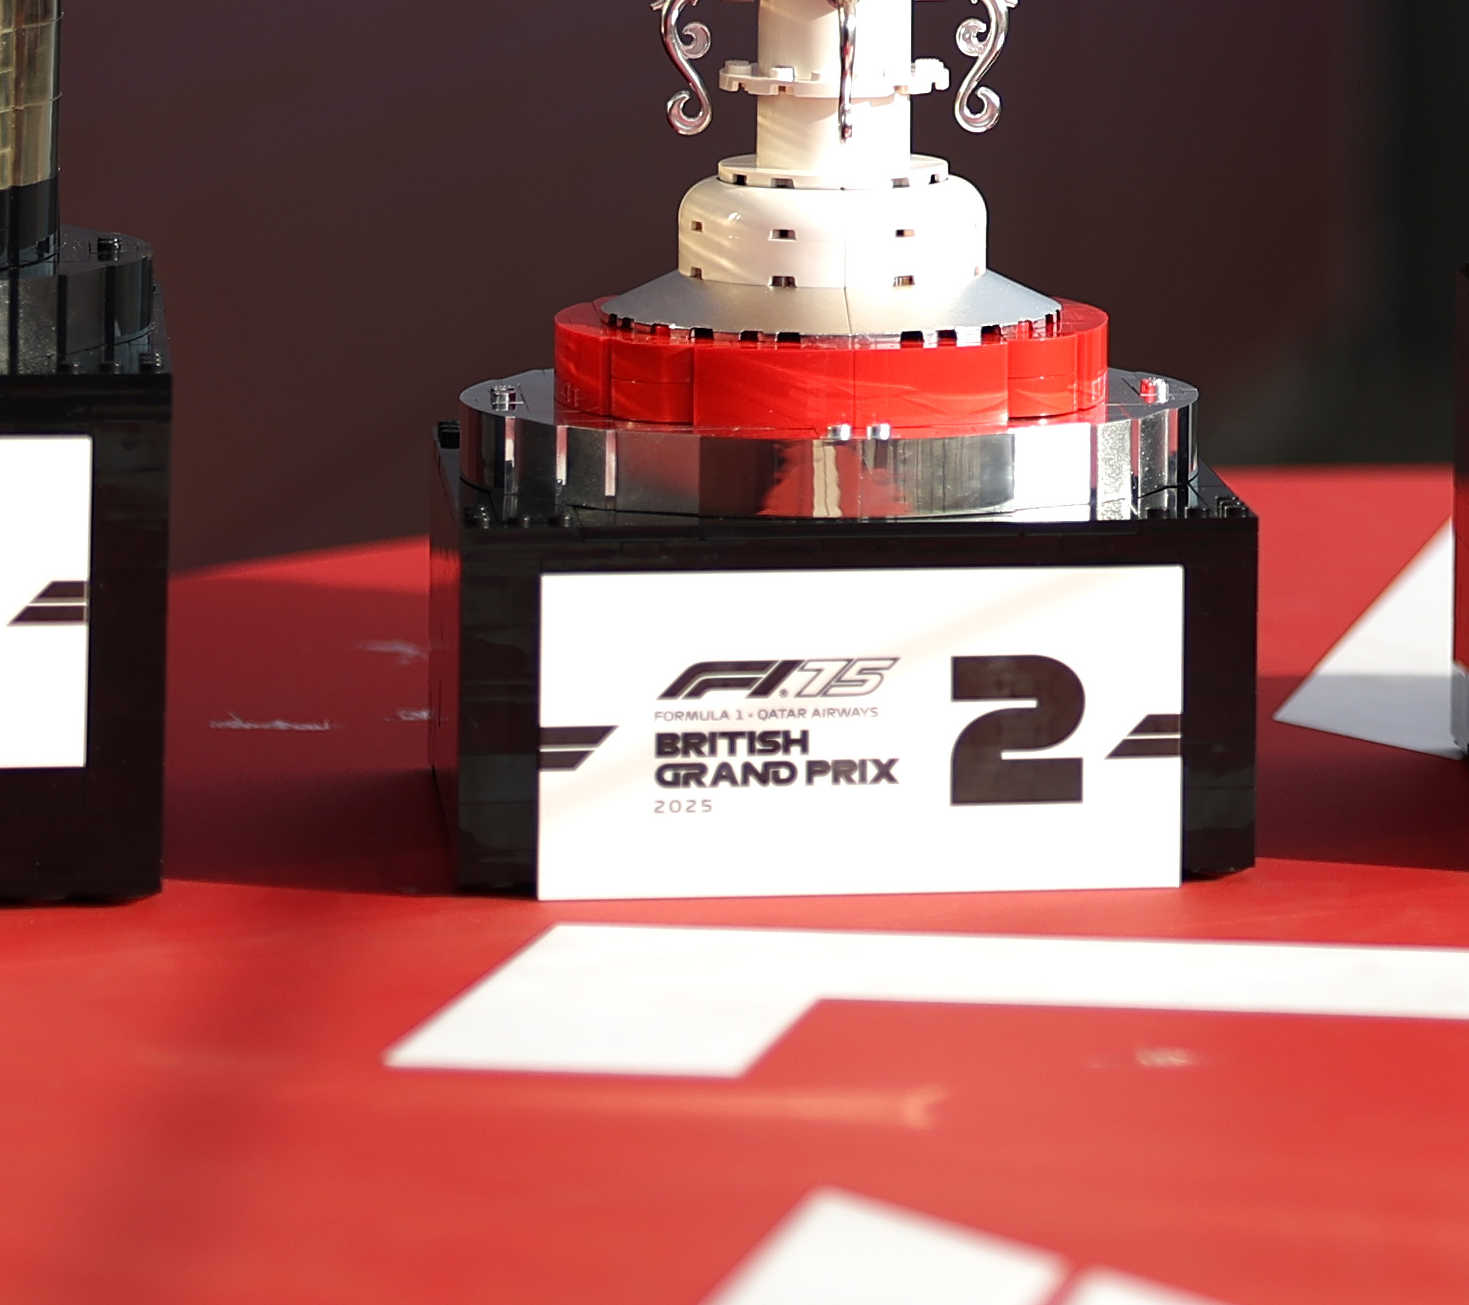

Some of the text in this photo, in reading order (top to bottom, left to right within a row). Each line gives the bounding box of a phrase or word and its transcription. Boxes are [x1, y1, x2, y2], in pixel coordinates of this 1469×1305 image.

[655, 707, 877, 721] FORMULA 1 QATAR AIRWAYS
[655, 730, 809, 758] BRITISH
[950, 654, 1086, 806] 2
[655, 758, 899, 788] GRAND PRIX
[654, 800, 711, 813] 2025
